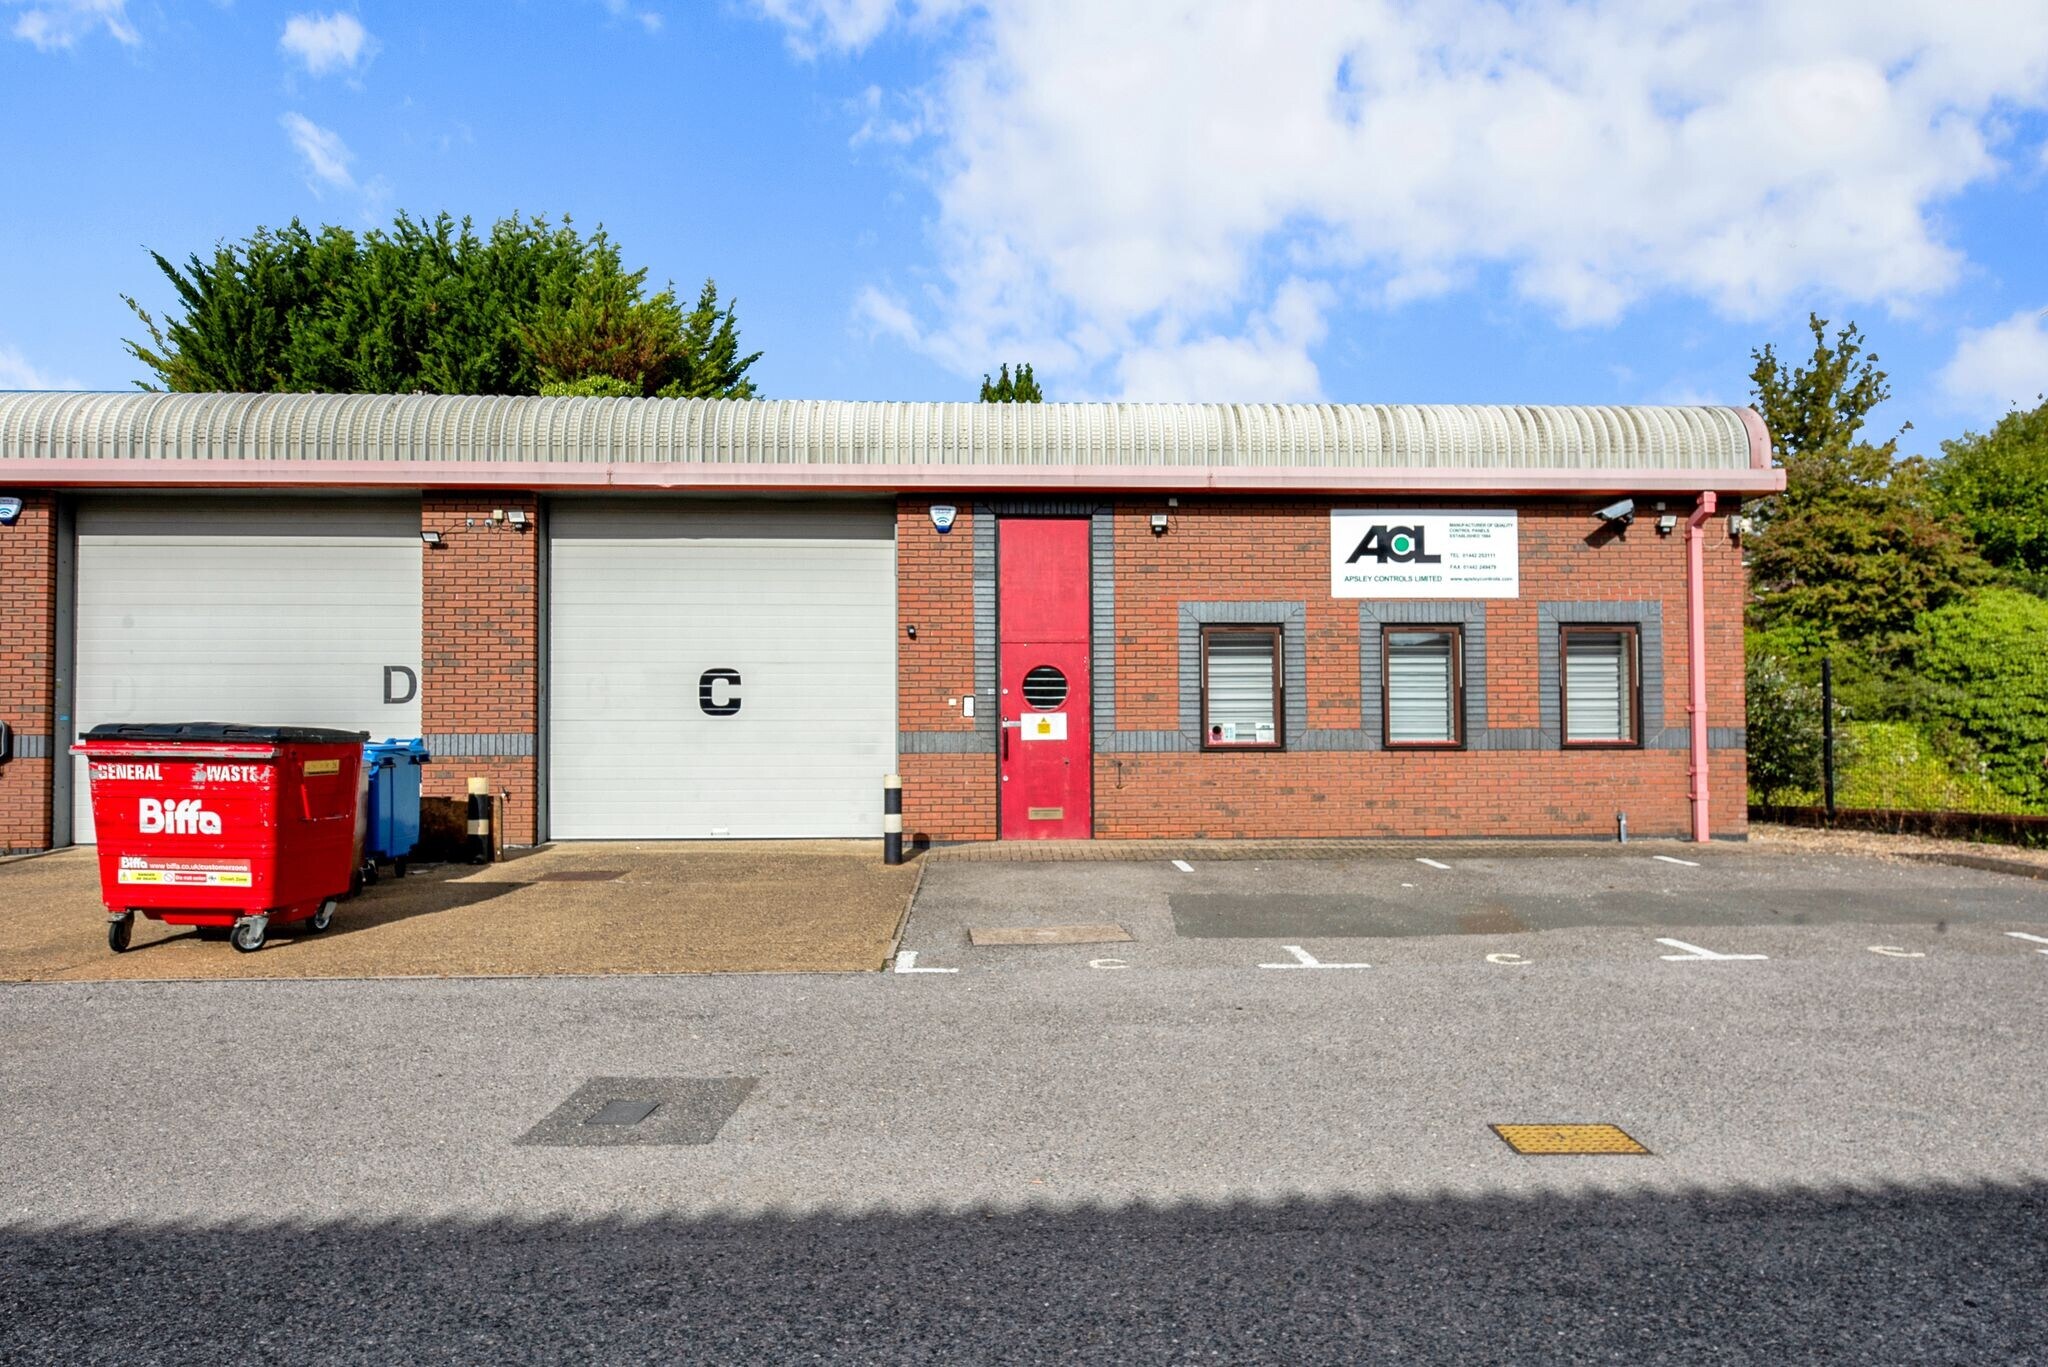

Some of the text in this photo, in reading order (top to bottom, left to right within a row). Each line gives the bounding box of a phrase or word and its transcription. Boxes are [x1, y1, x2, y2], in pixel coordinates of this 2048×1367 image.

[1345, 525, 1441, 563] ACL
[383, 665, 417, 704] D
[699, 667, 742, 716] C
[98, 764, 163, 781] GENERAL
[139, 798, 221, 835] Biffa
[121, 856, 148, 869] Biffa
